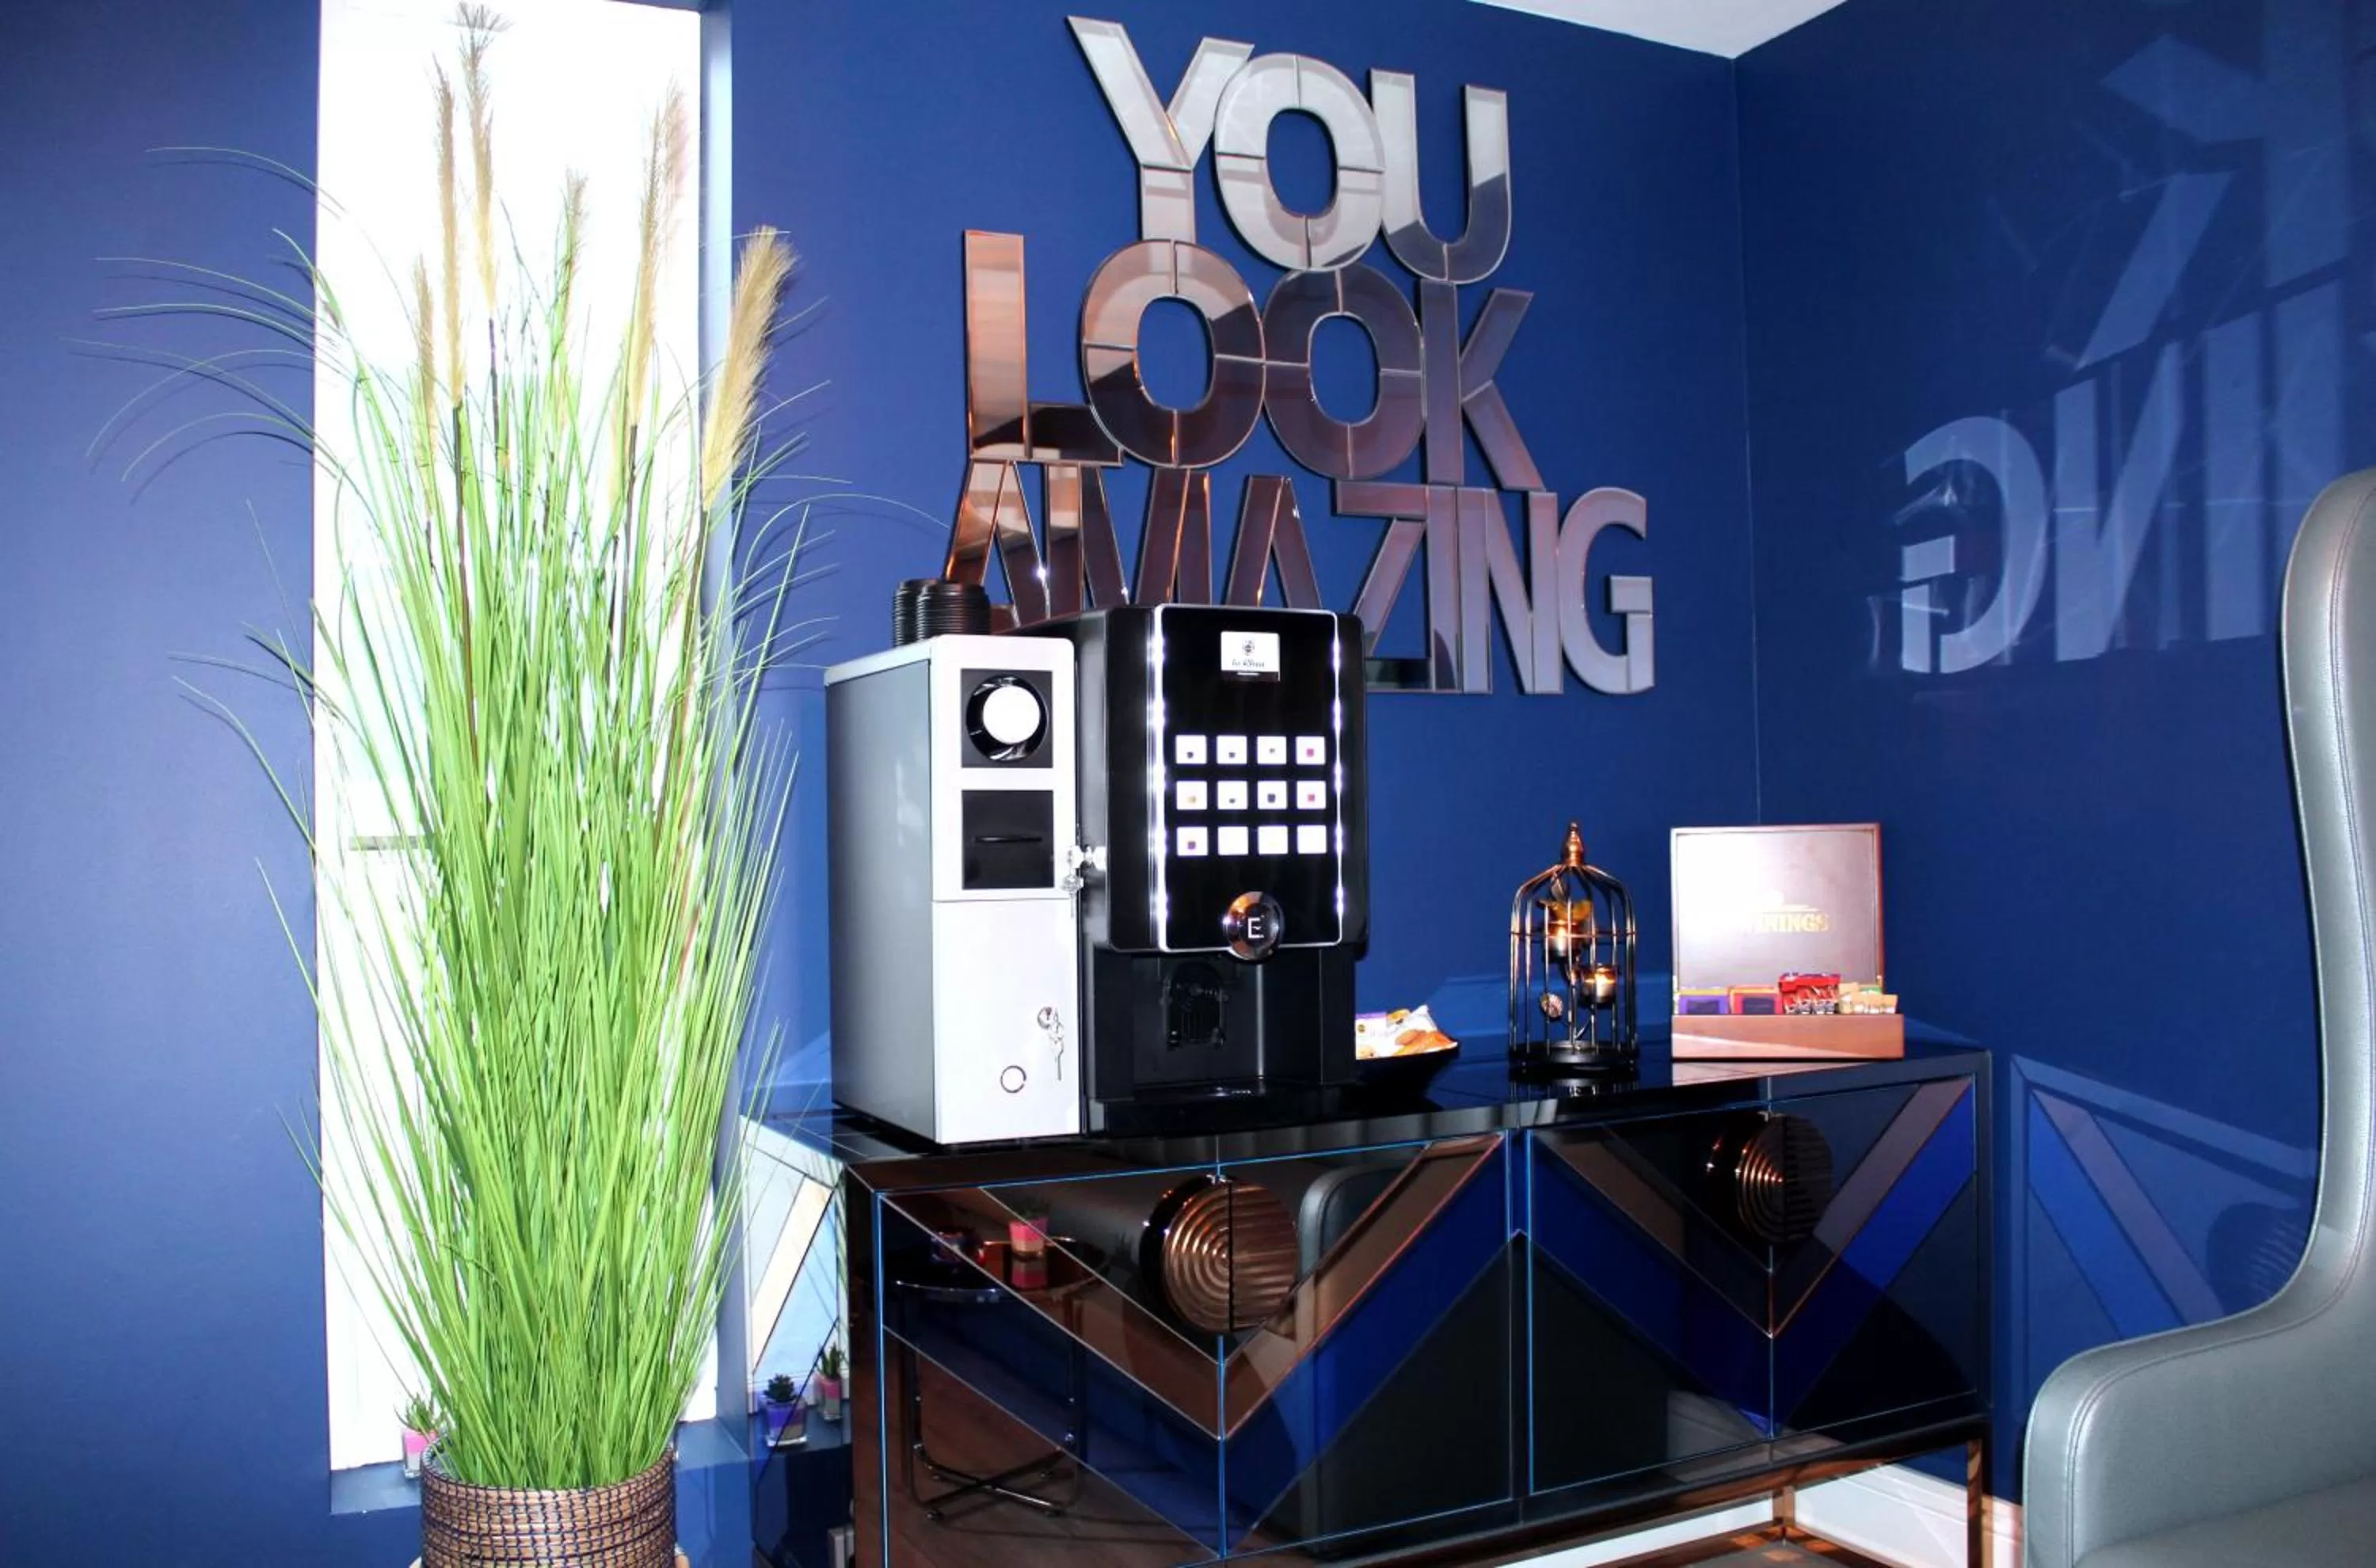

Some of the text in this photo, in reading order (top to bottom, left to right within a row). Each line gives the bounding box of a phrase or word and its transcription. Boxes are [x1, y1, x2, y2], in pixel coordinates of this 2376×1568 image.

[1066, 15, 1512, 284] YOU
[964, 230, 1547, 490] LOOK
[941, 459, 1655, 694] AMAZING
